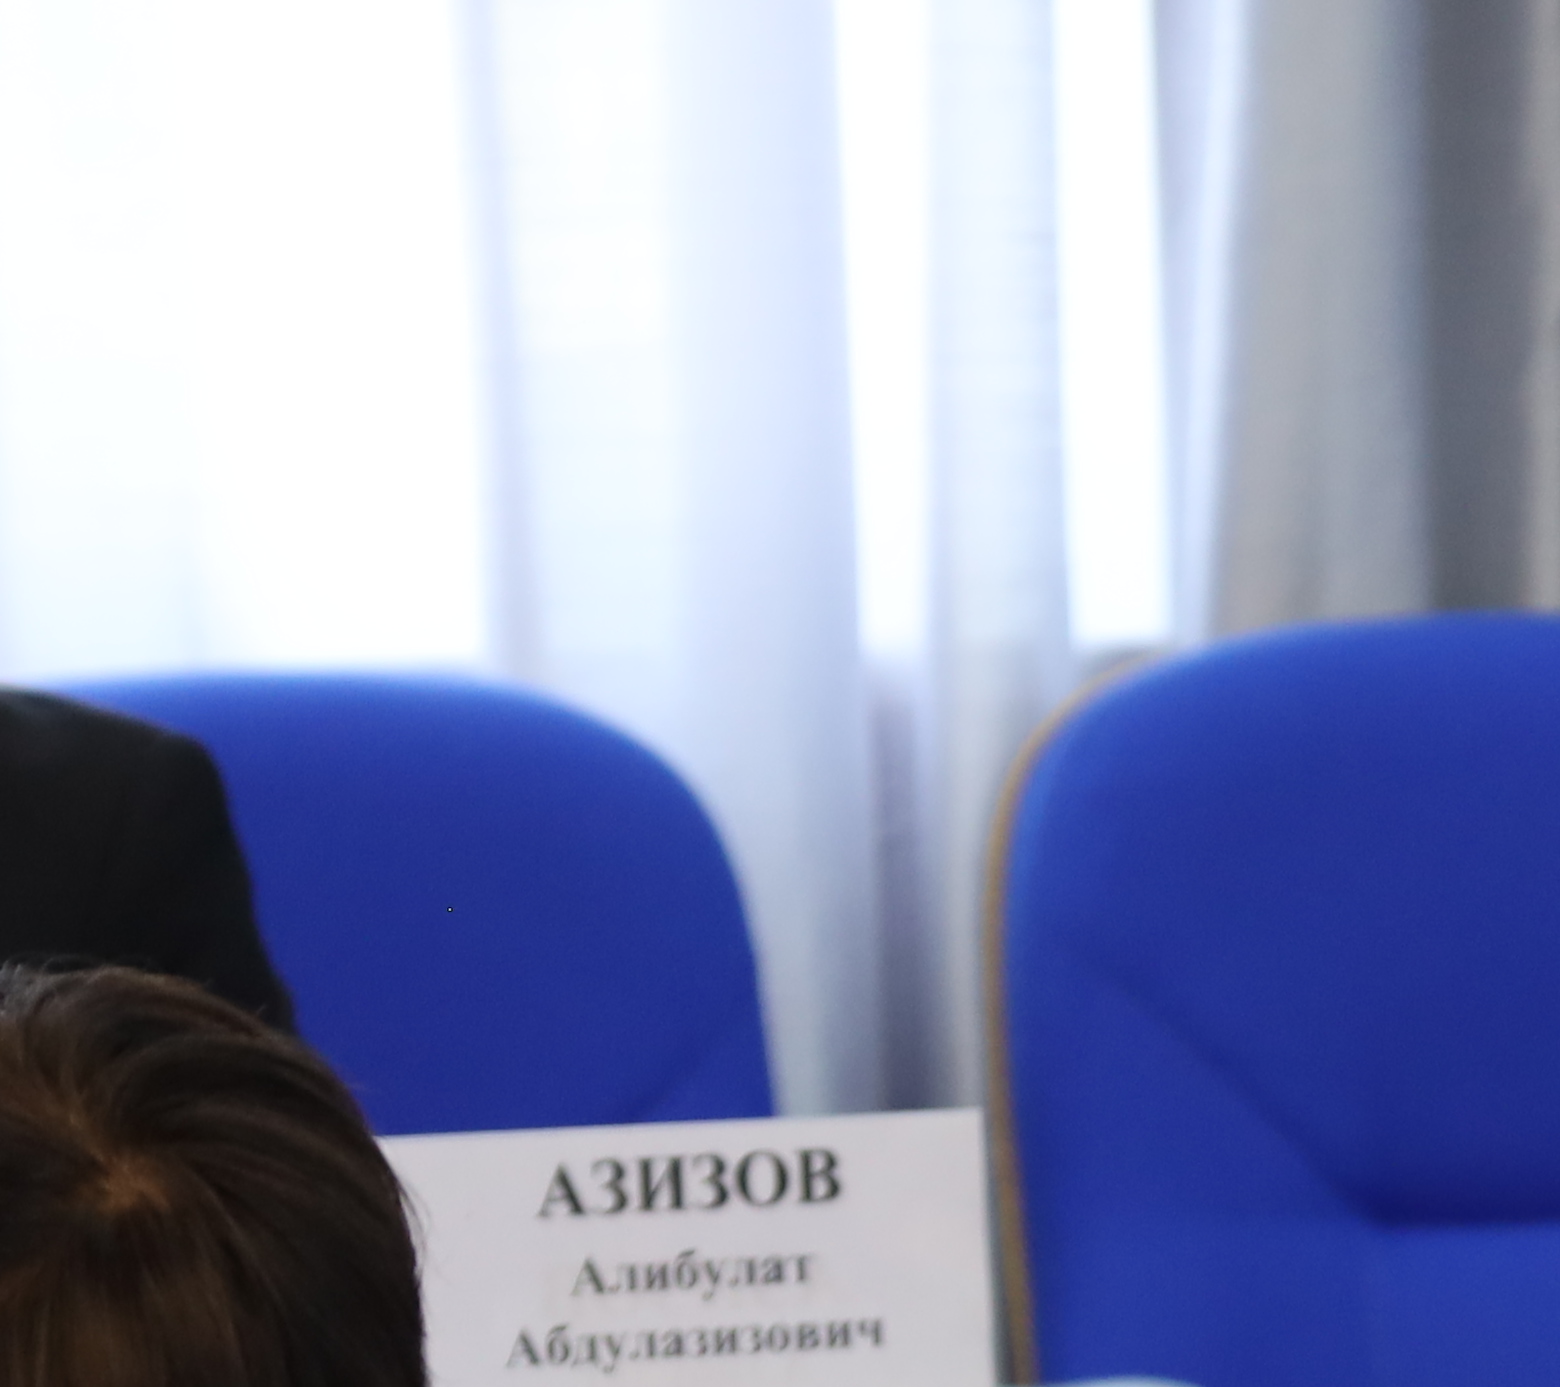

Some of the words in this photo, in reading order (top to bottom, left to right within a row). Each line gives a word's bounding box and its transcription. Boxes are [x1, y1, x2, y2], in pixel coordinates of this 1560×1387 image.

[538, 1147, 843, 1218] АЗИЗОВ
[572, 1248, 812, 1301] Алибулат
[506, 1317, 885, 1374] Абдулазизович
